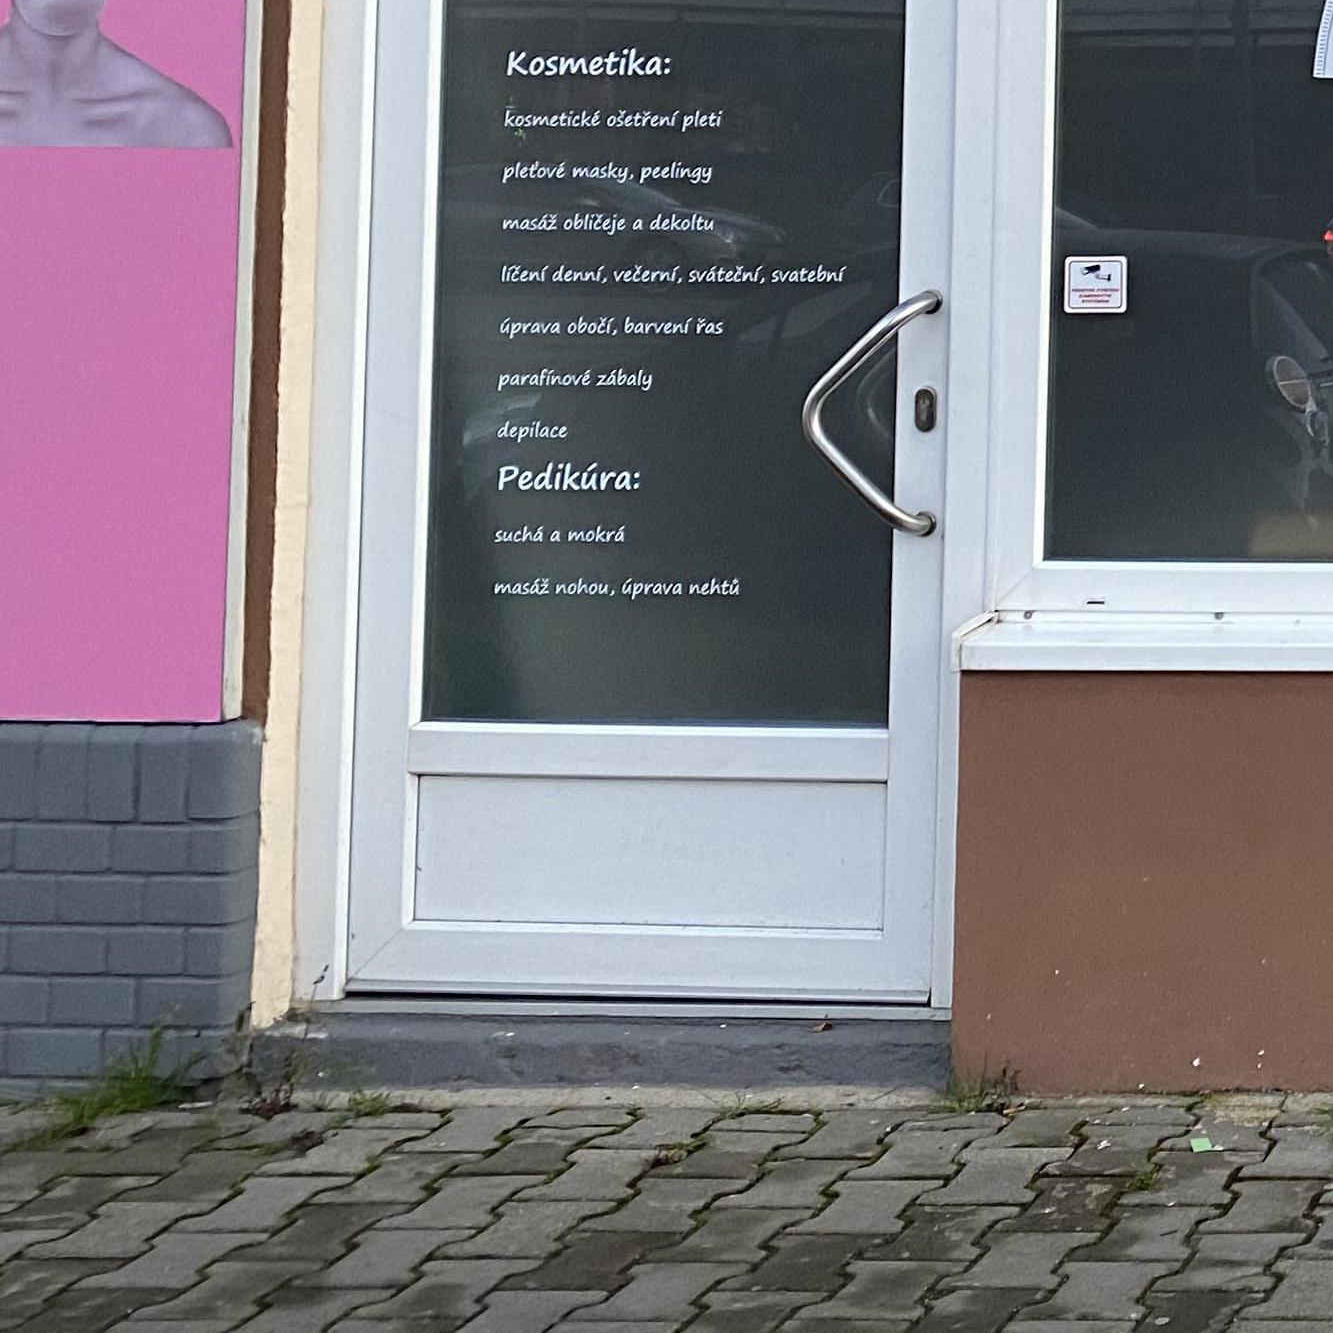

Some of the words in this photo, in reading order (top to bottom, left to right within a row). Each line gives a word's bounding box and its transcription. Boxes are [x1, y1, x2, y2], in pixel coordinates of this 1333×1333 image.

[506, 48, 671, 76] Kosmetika:
[504, 109, 601, 127] kosmetické
[606, 109, 680, 128] ošetření
[681, 110, 723, 132] pleti
[502, 160, 566, 184] pleťové
[572, 161, 634, 184] masky,
[639, 161, 713, 184] peelingy
[502, 214, 557, 231] masáž
[563, 213, 626, 236] obličeje
[632, 218, 643, 230] a
[649, 213, 714, 231] dekoltu
[501, 265, 549, 282] líčení
[552, 265, 607, 284] denní,
[613, 264, 682, 284] večerní,
[688, 265, 765, 285] sváteční,
[771, 264, 847, 283] svatební
[499, 317, 560, 339] úprava
[567, 316, 618, 336] obočí,
[624, 316, 693, 334] barvení
[696, 317, 724, 335] řas
[497, 368, 591, 392] parafínové
[595, 368, 653, 391] zábaly
[497, 421, 567, 443] depilace
[498, 462, 640, 491] Pedikúra:
[494, 525, 544, 543] suchá
[549, 530, 561, 542] a
[567, 525, 625, 543] mokrá
[494, 578, 550, 595] masáž
[555, 577, 615, 596] nohou,
[621, 578, 682, 600] úprava
[688, 578, 740, 596] nehtů
